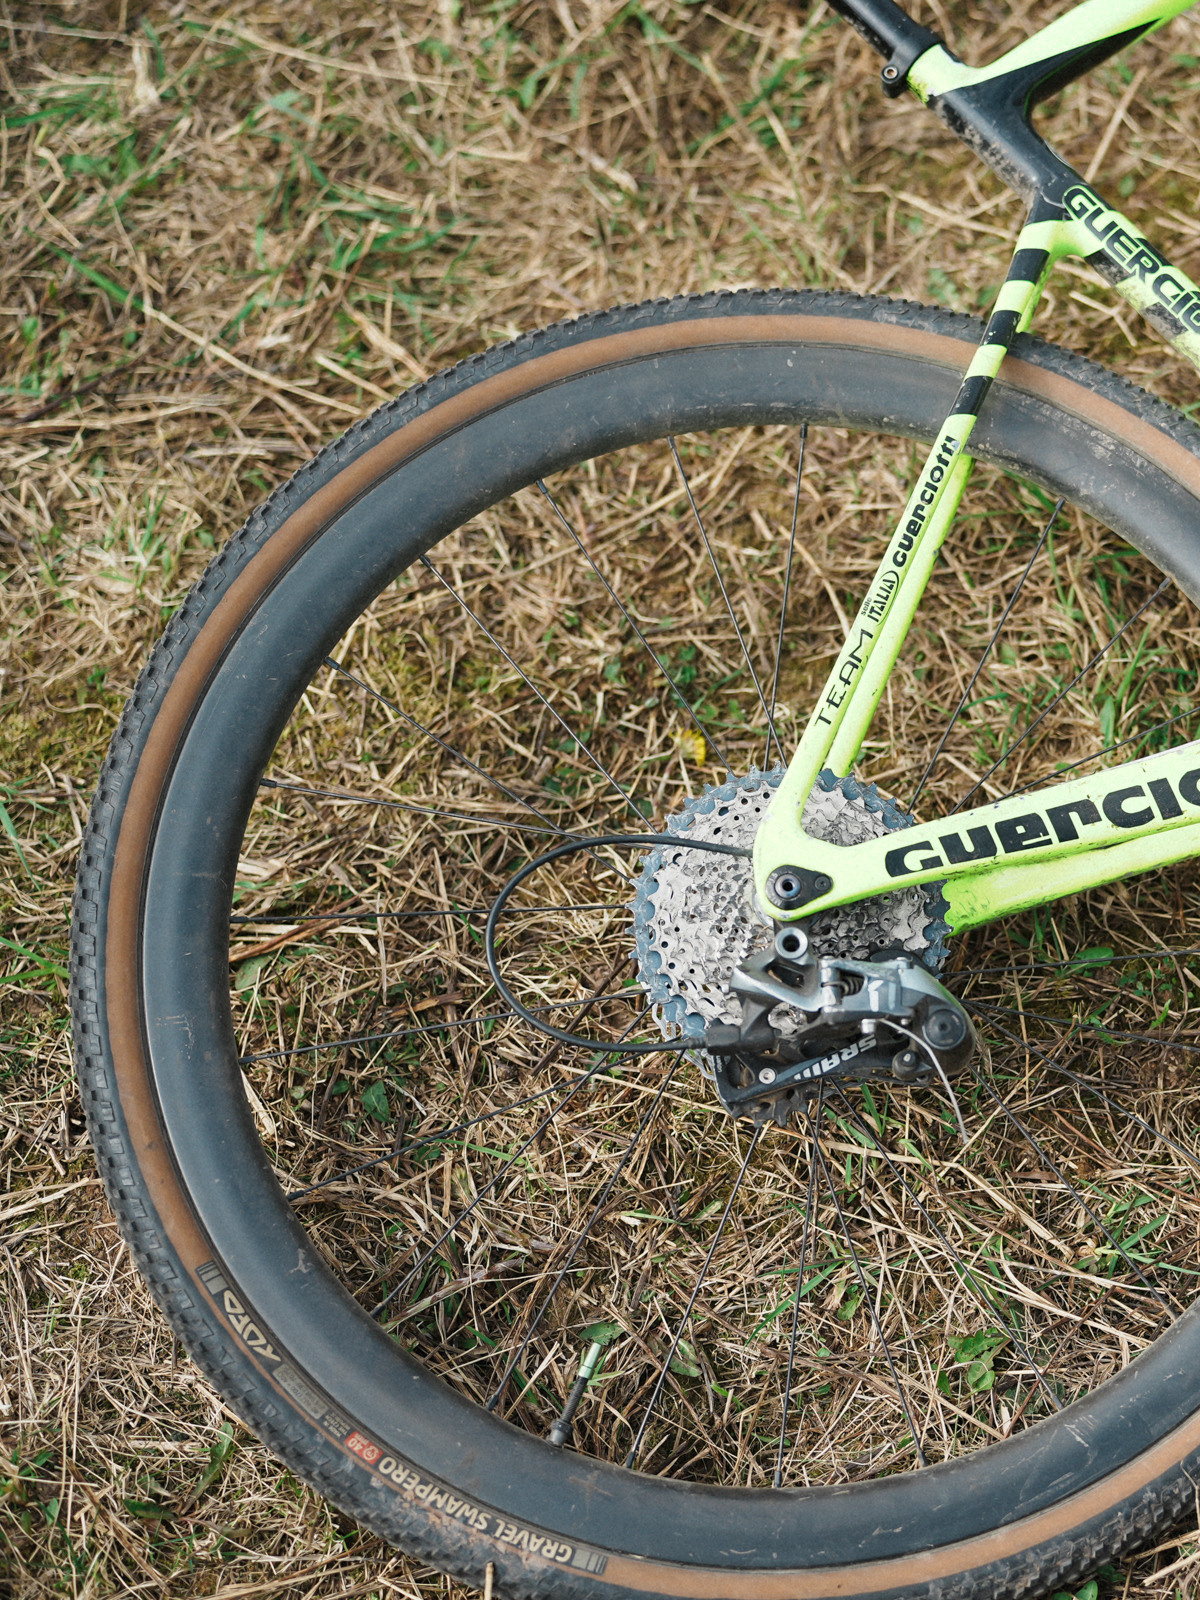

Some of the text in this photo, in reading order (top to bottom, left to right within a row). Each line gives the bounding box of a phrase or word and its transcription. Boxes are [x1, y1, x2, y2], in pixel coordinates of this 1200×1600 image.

[867, 577, 896, 623] ITALIA
[814, 628, 874, 726] TEAM
[347, 1437, 363, 1451] 40
[378, 1456, 573, 1563] GRAVEL SWAMPERO
